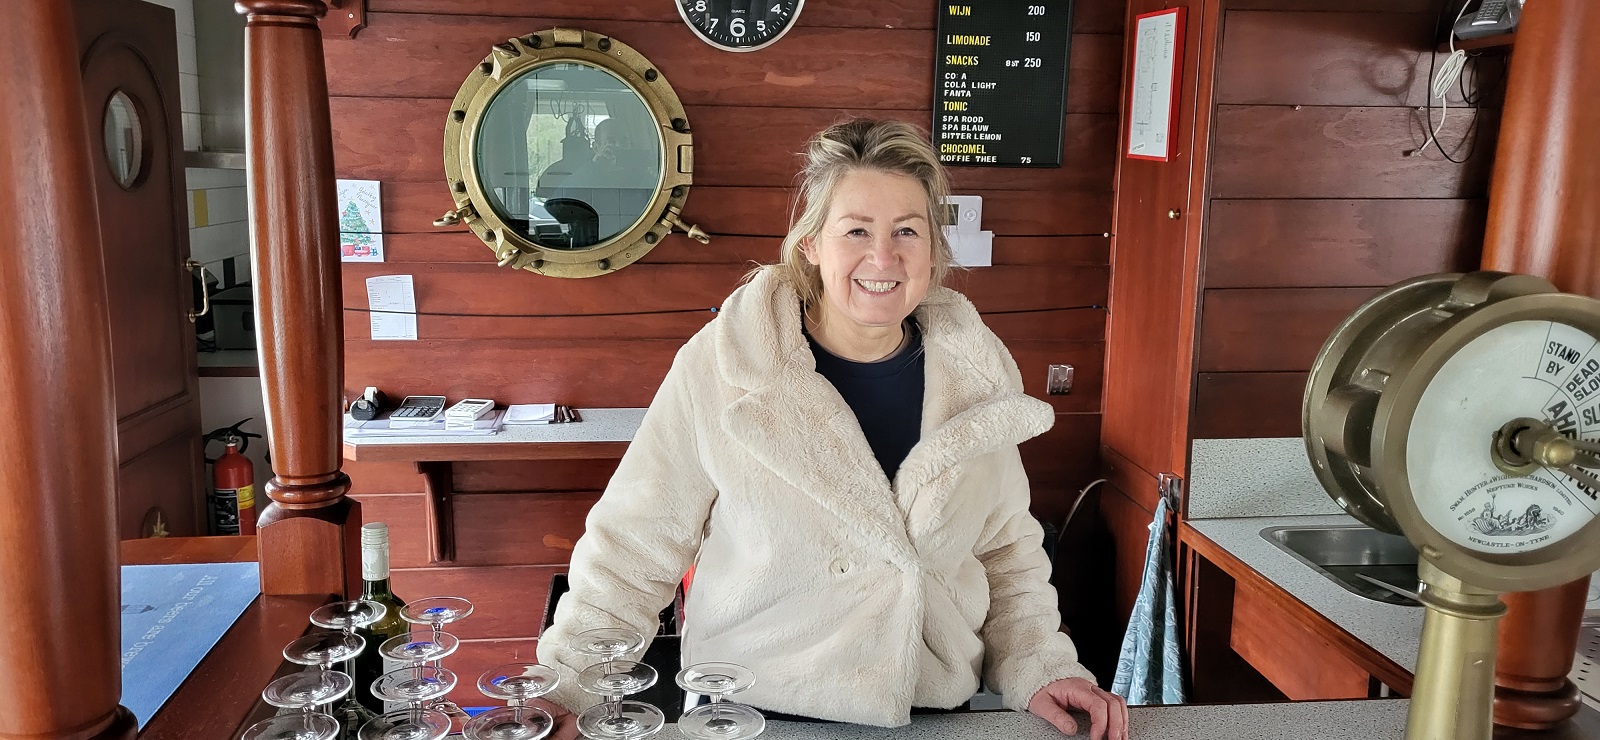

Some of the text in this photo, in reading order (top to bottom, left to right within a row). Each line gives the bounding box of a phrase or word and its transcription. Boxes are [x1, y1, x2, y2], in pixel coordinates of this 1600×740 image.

[695, 0, 706, 11] 8
[771, 3, 781, 14] 4
[949, 5, 1045, 16] WIJN 200
[710, 18, 718, 30] 7
[730, 17, 746, 37] 6
[756, 20, 766, 31] 5
[946, 32, 1041, 46] LIMONADE 150
[946, 55, 979, 66] SNACKS
[1024, 58, 1041, 68] 250
[944, 72, 967, 80] COA
[944, 81, 997, 90] COLA LIGHT
[943, 101, 968, 111] TONIC
[961, 124, 990, 132] BLAUW
[941, 132, 1002, 141] BITTER LEMON
[940, 143, 987, 154] CHOCOMEL
[975, 155, 997, 163] THEE
[1546, 341, 1581, 365] STAND
[1546, 360, 1566, 377] BY
[1566, 359, 1600, 393] DEAD
[1486, 482, 1538, 494] NEPTUNE WORKS
[182, 586, 203, 601] our
[158, 602, 193, 624] beers
[142, 624, 165, 641] are
